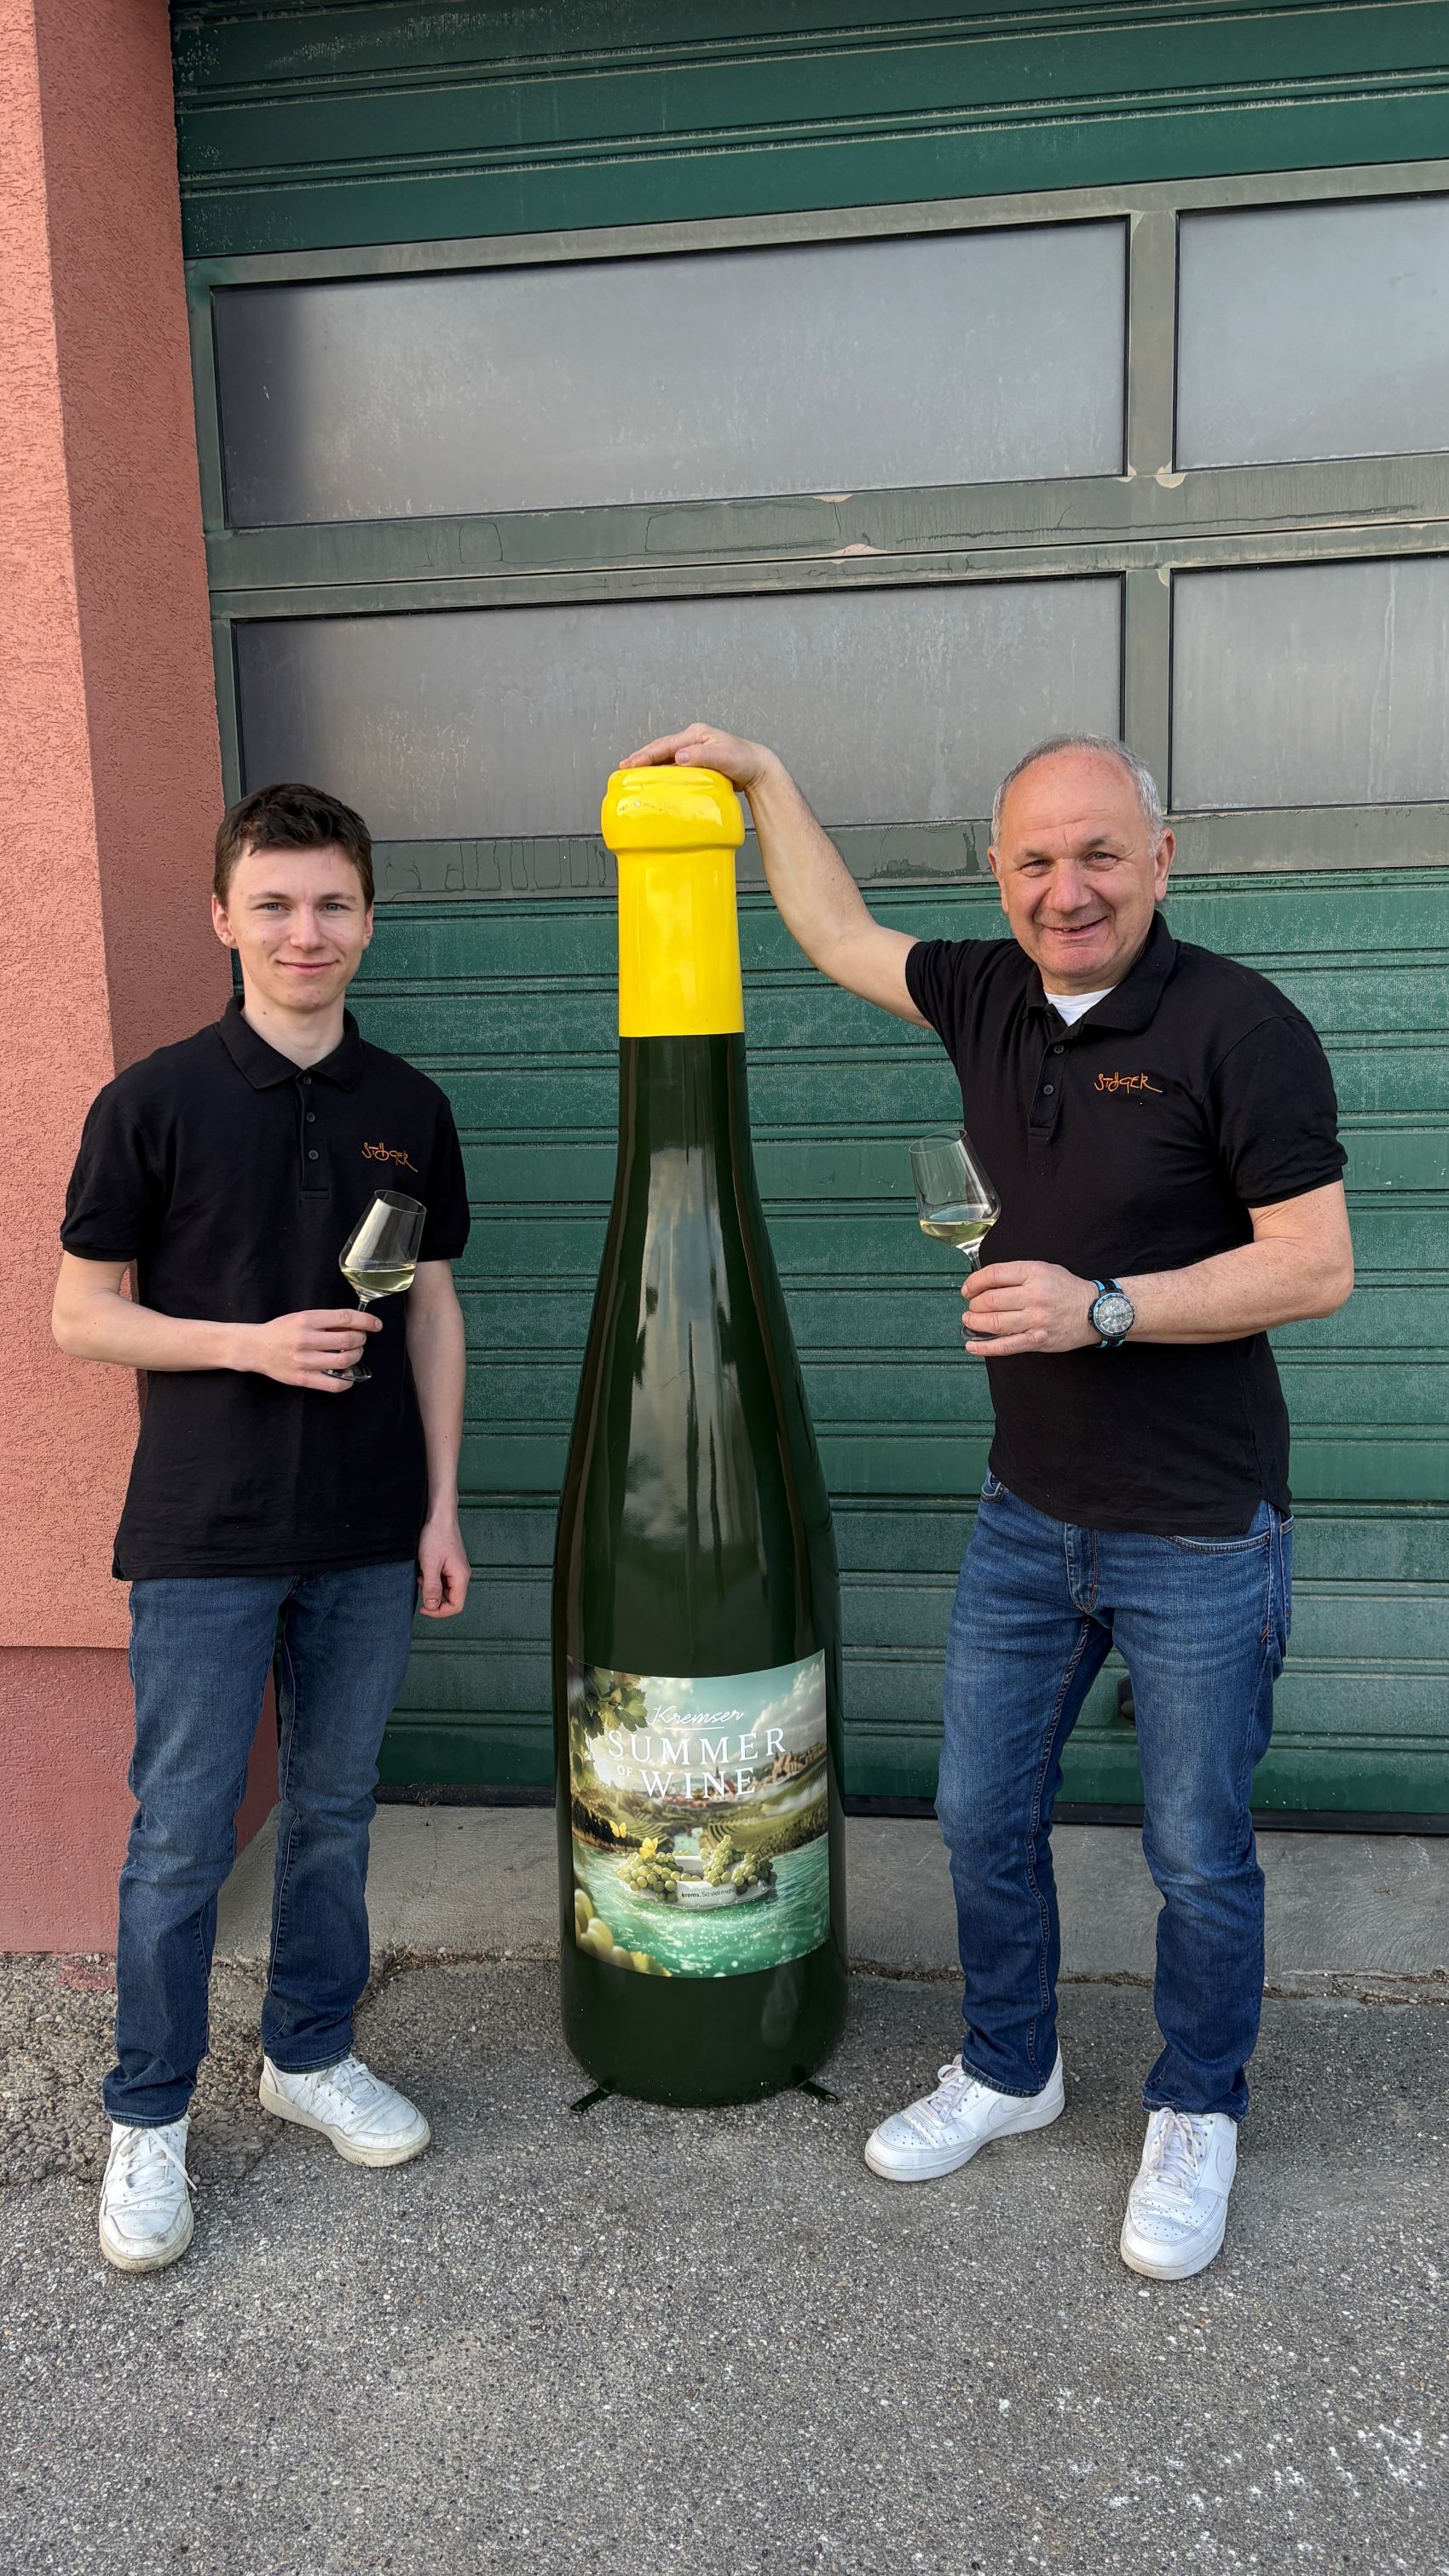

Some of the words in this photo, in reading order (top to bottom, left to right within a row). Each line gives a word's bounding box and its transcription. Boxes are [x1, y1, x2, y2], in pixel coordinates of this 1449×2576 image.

[647, 1704, 745, 1726] Kremser
[608, 1727, 787, 1765] SUMMER
[616, 1765, 633, 1777] OF
[639, 1766, 756, 1799] WINE
